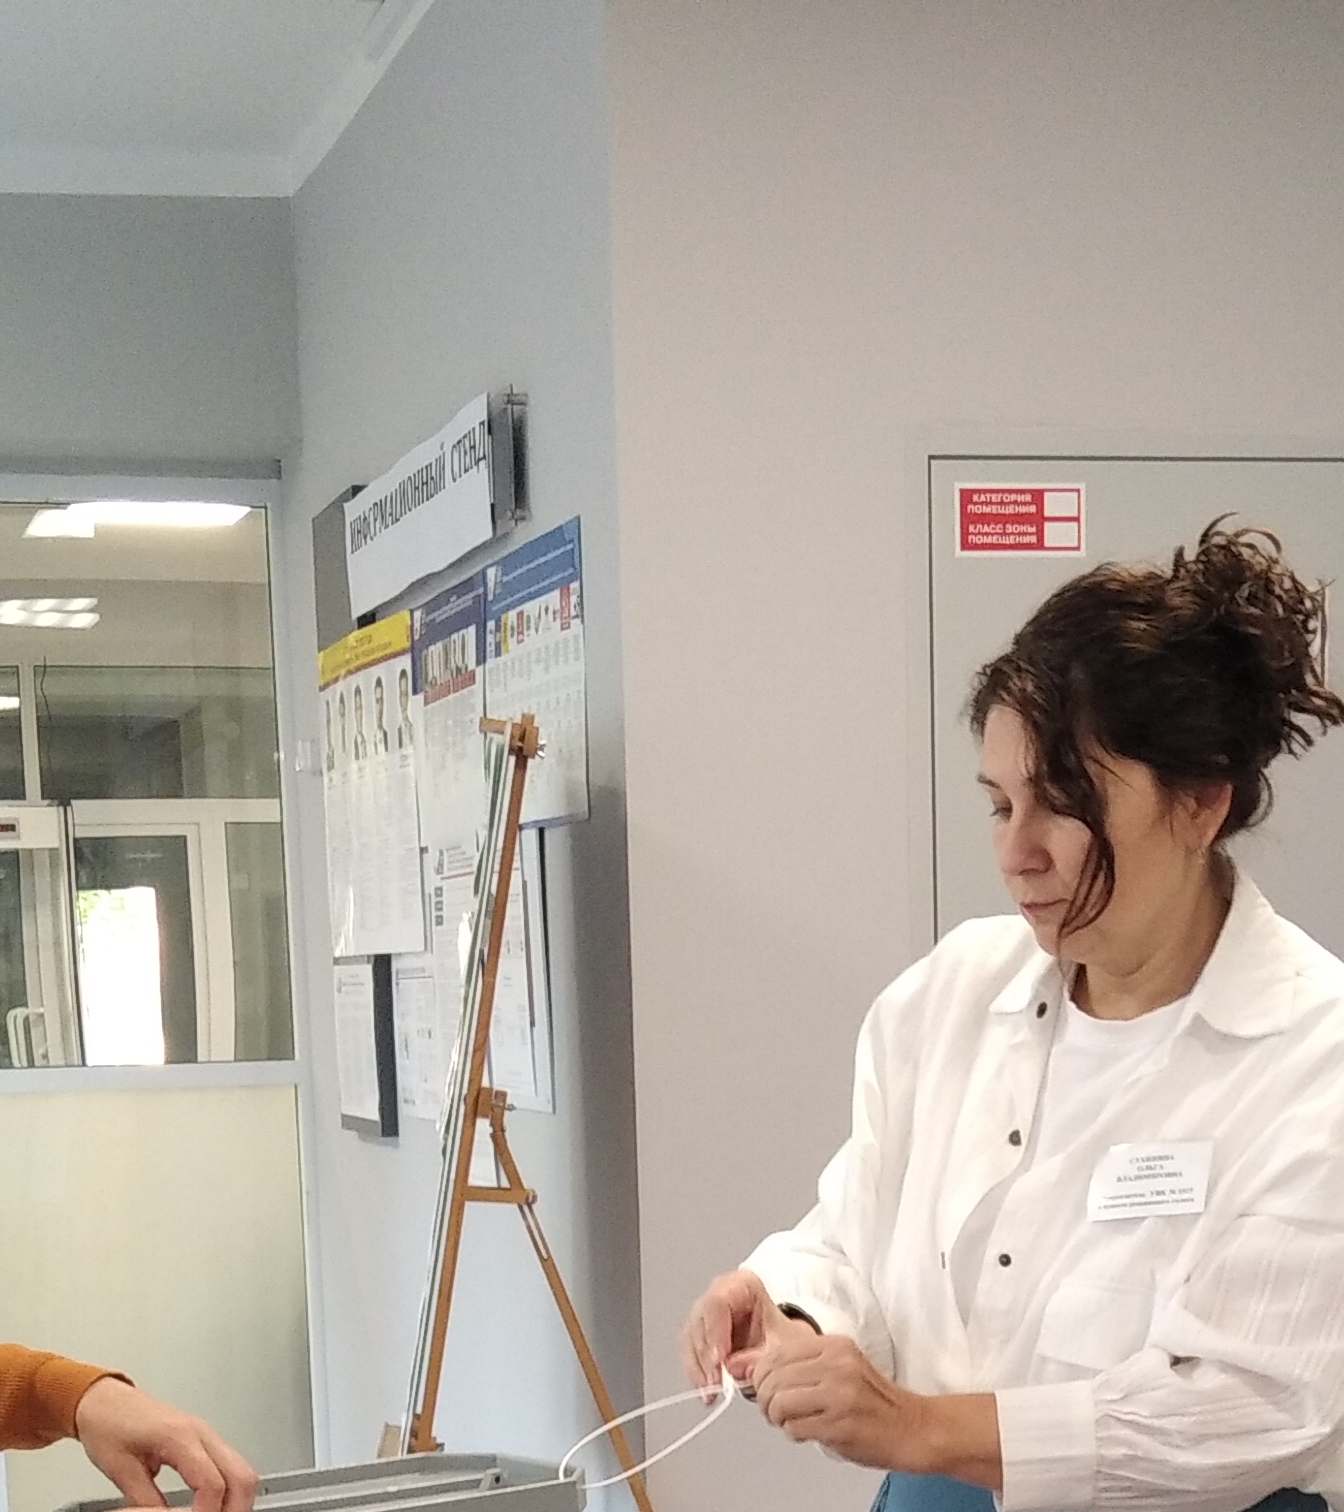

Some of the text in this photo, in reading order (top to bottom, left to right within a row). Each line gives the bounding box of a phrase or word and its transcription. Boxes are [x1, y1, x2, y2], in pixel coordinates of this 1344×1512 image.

[350, 419, 487, 555] ИНФОРМАЦИОННЫЙ СТЕНД
[972, 493, 1032, 503] КАТЕГОРИЯ
[967, 504, 1037, 515] ПОМЕЩЕНИЯ
[968, 523, 1037, 533] КЛАСС ЗОНЫ
[968, 534, 1038, 545] ПОМЕЩЕНИЯ
